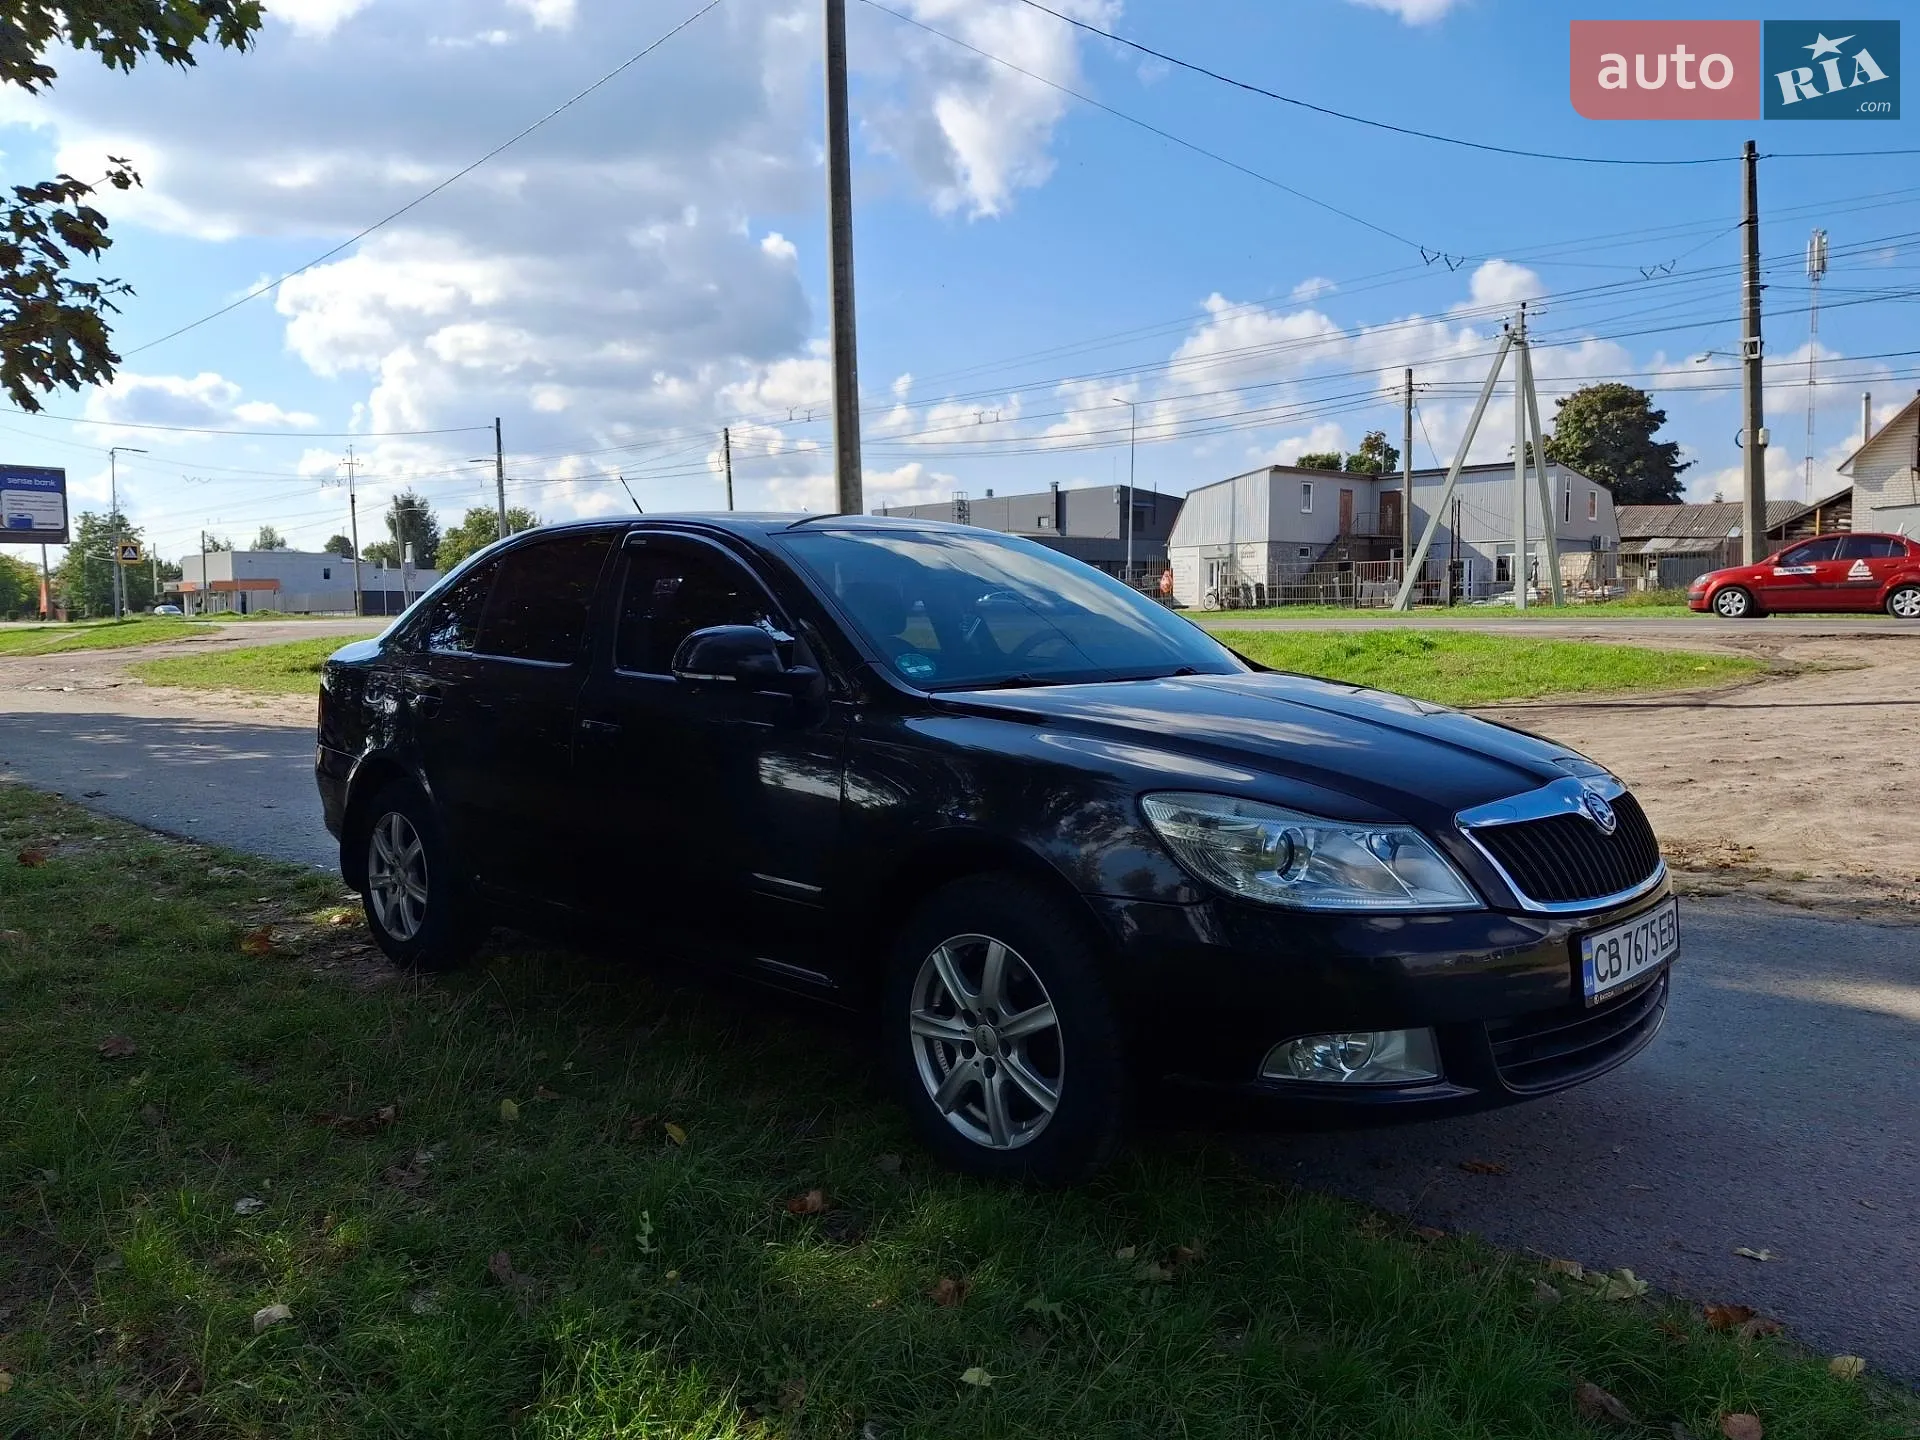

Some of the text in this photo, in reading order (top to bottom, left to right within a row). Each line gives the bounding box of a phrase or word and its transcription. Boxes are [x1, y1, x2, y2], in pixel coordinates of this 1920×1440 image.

[34, 478, 56, 487] bank
[1595, 908, 1676, 983] CB 7675 EB
